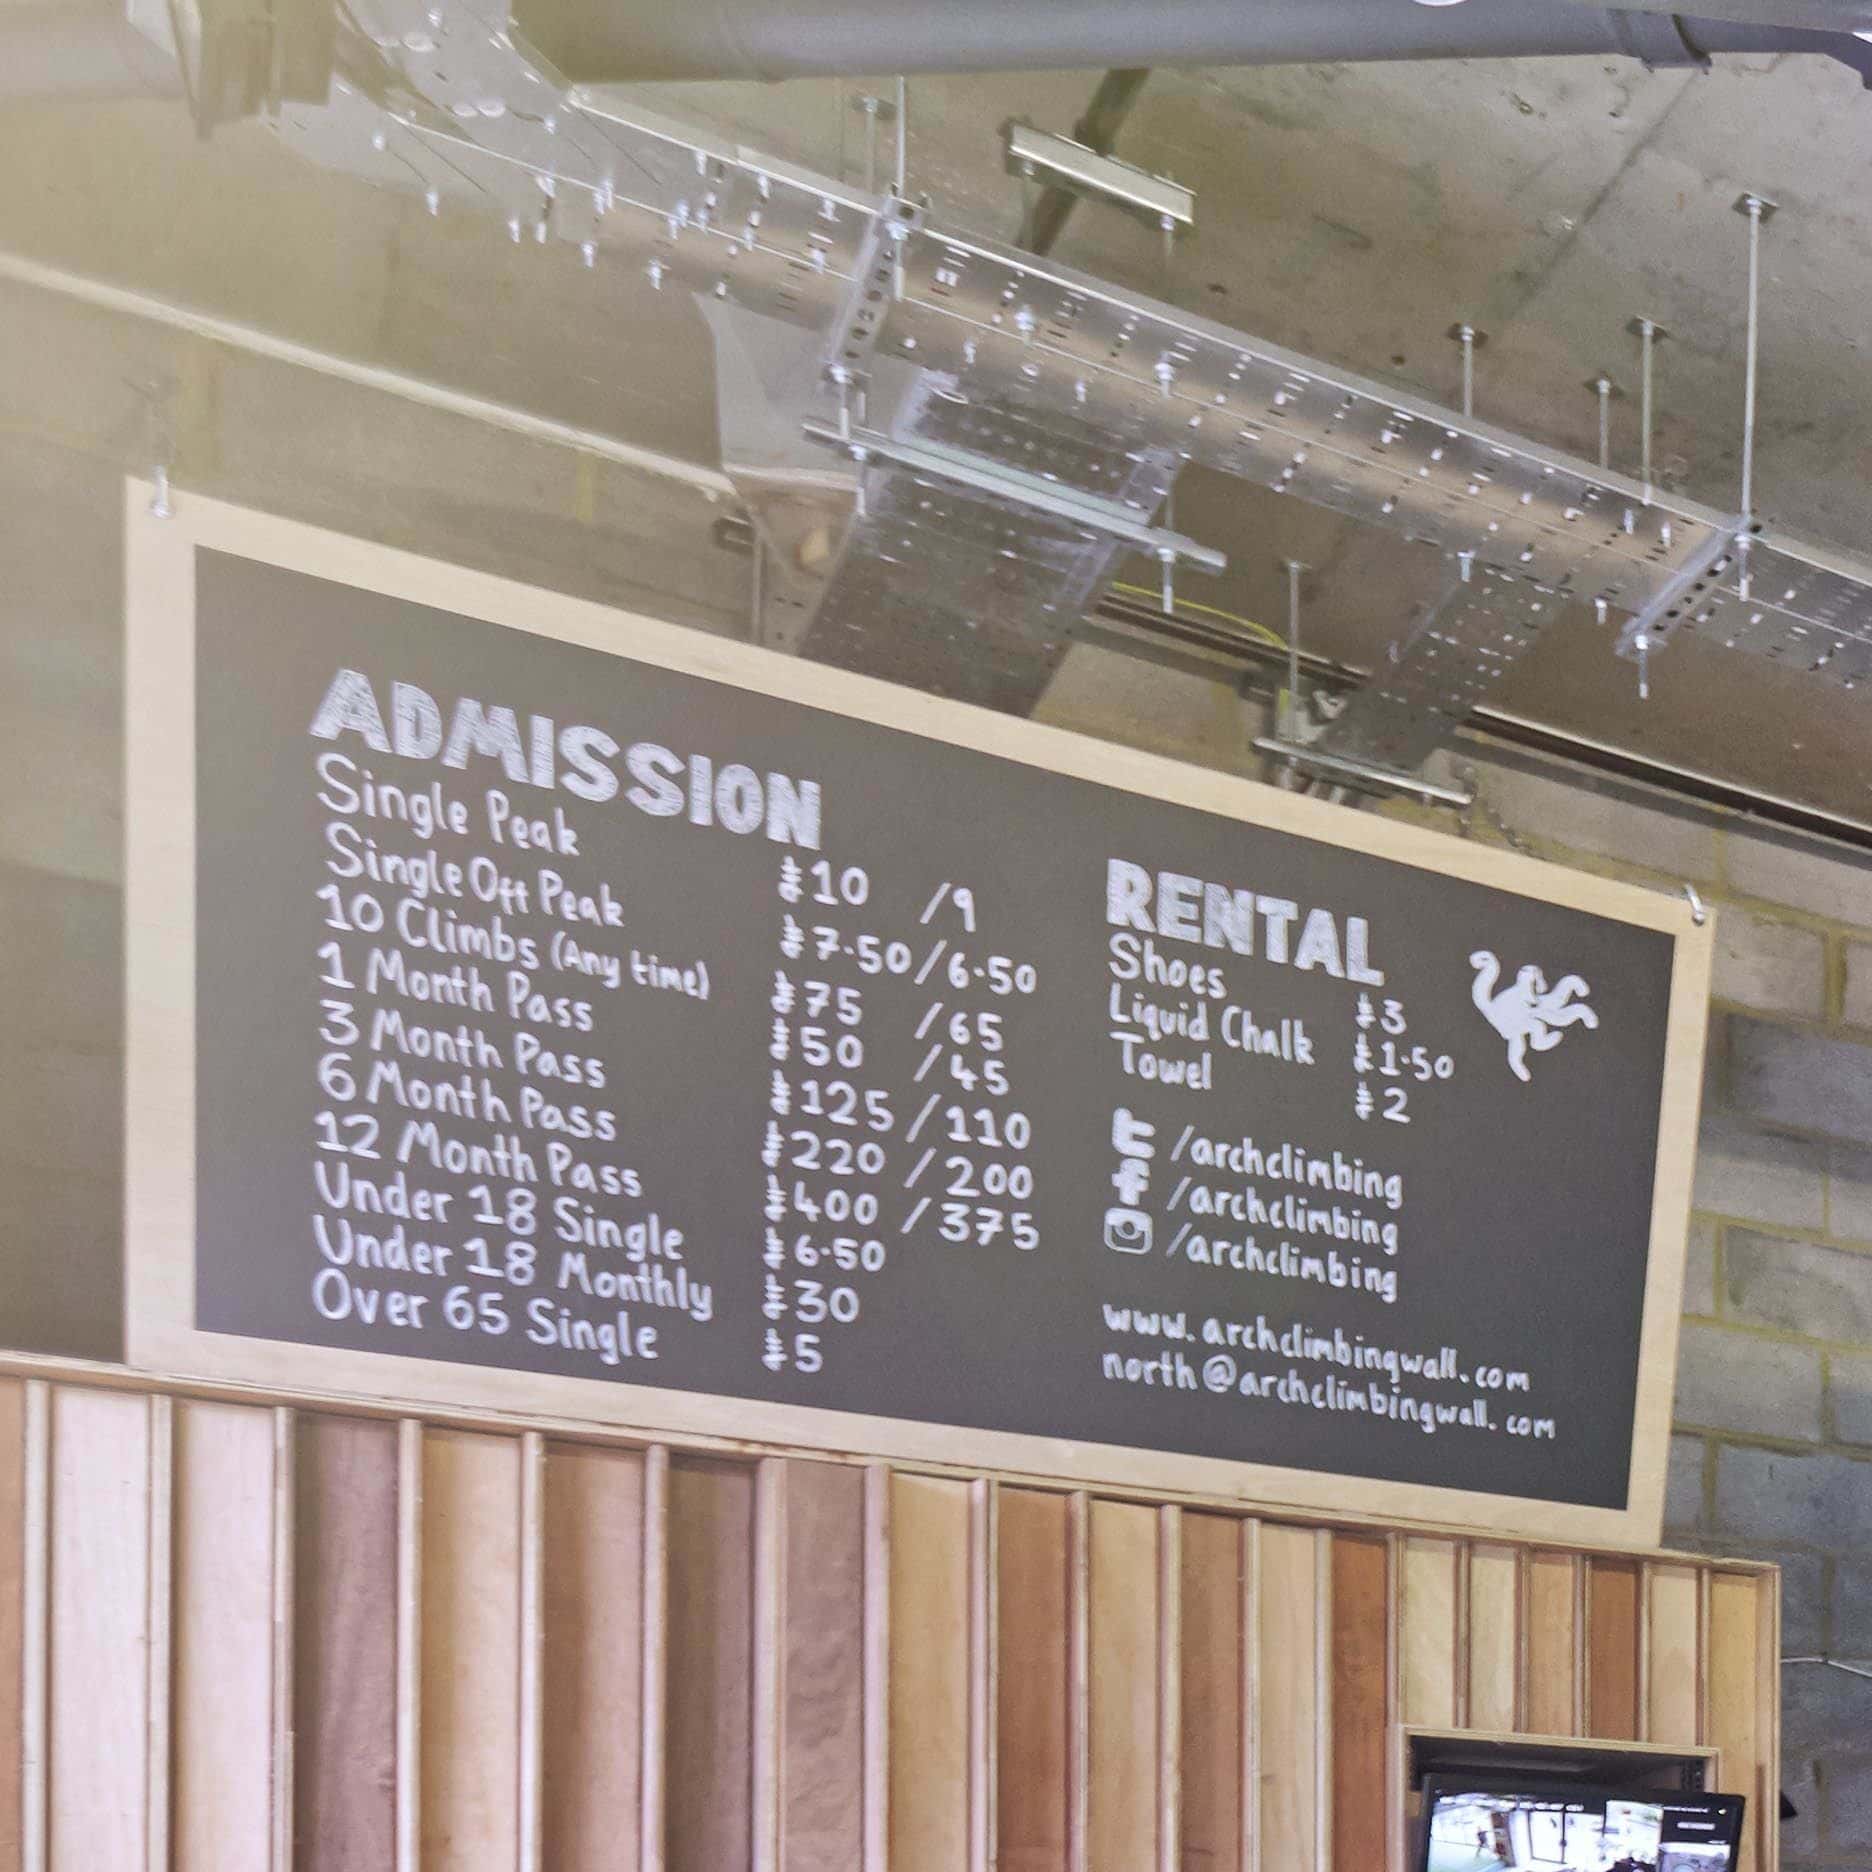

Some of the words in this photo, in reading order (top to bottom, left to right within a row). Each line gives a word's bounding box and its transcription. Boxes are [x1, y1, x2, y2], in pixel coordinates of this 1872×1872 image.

[309, 669, 821, 850] ADMISSION
[316, 752, 469, 839] Single
[487, 789, 581, 856] Peak
[325, 822, 463, 899] Single
[538, 869, 625, 927] Peak
[316, 883, 384, 932] 10
[399, 898, 540, 970] Climbs
[550, 930, 622, 990] (Any
[631, 949, 709, 1001] time)
[1106, 858, 1385, 987] RENTAL
[1108, 933, 1227, 999] Shoes
[317, 942, 355, 990] 1
[366, 948, 496, 1014] Month
[506, 970, 594, 1033] Pass
[1109, 982, 1209, 1042] Liquid
[1222, 1005, 1316, 1066] Chalk
[318, 998, 360, 1045] 3
[368, 1008, 504, 1069] Month
[512, 1031, 607, 1089] Pass
[1110, 1030, 1212, 1090] Towel
[316, 1052, 356, 1101] 6
[365, 1058, 512, 1123] Month
[518, 1085, 616, 1141] Pass
[313, 1110, 381, 1160] 12
[397, 1120, 539, 1183] Month
[546, 1141, 642, 1198] Pass
[1170, 1124, 1403, 1210] /archclimbing
[313, 1160, 455, 1223] Under
[468, 1184, 538, 1237] 18
[553, 1196, 684, 1262] Single
[1166, 1176, 1398, 1256] /archclimbing
[312, 1214, 455, 1277] Under
[463, 1236, 538, 1288] 18
[556, 1251, 713, 1322] Monthly
[1165, 1222, 1398, 1303] /archclimbing
[312, 1267, 431, 1328] Over
[443, 1285, 511, 1335] 65
[524, 1297, 660, 1366] Single
